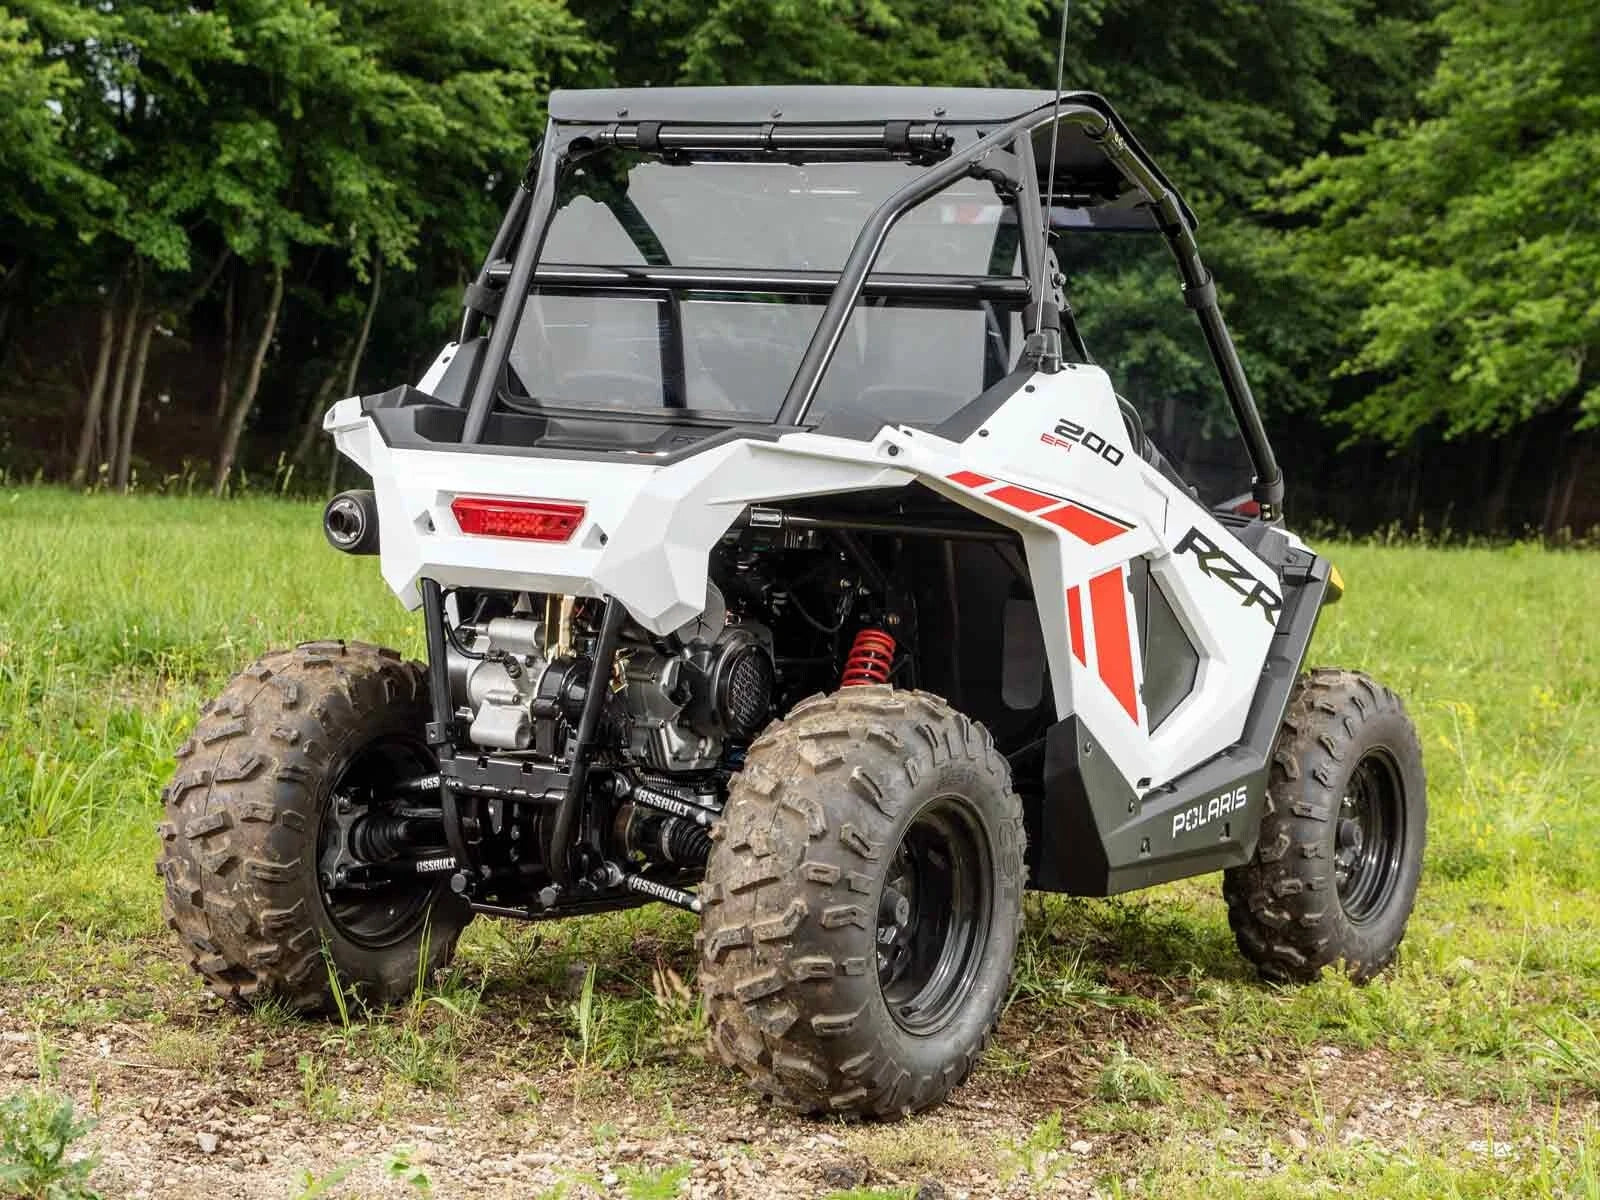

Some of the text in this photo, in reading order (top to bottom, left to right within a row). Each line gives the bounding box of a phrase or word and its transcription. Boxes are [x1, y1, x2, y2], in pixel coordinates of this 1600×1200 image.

[1040, 432, 1073, 453] EFI
[1054, 418, 1125, 467] 200
[1172, 526, 1282, 627] RZR
[638, 789, 692, 817] ASSAULT
[1172, 785, 1248, 839] POLARIS
[416, 857, 457, 873] ASSAULT
[632, 876, 687, 904] ASSAULT
